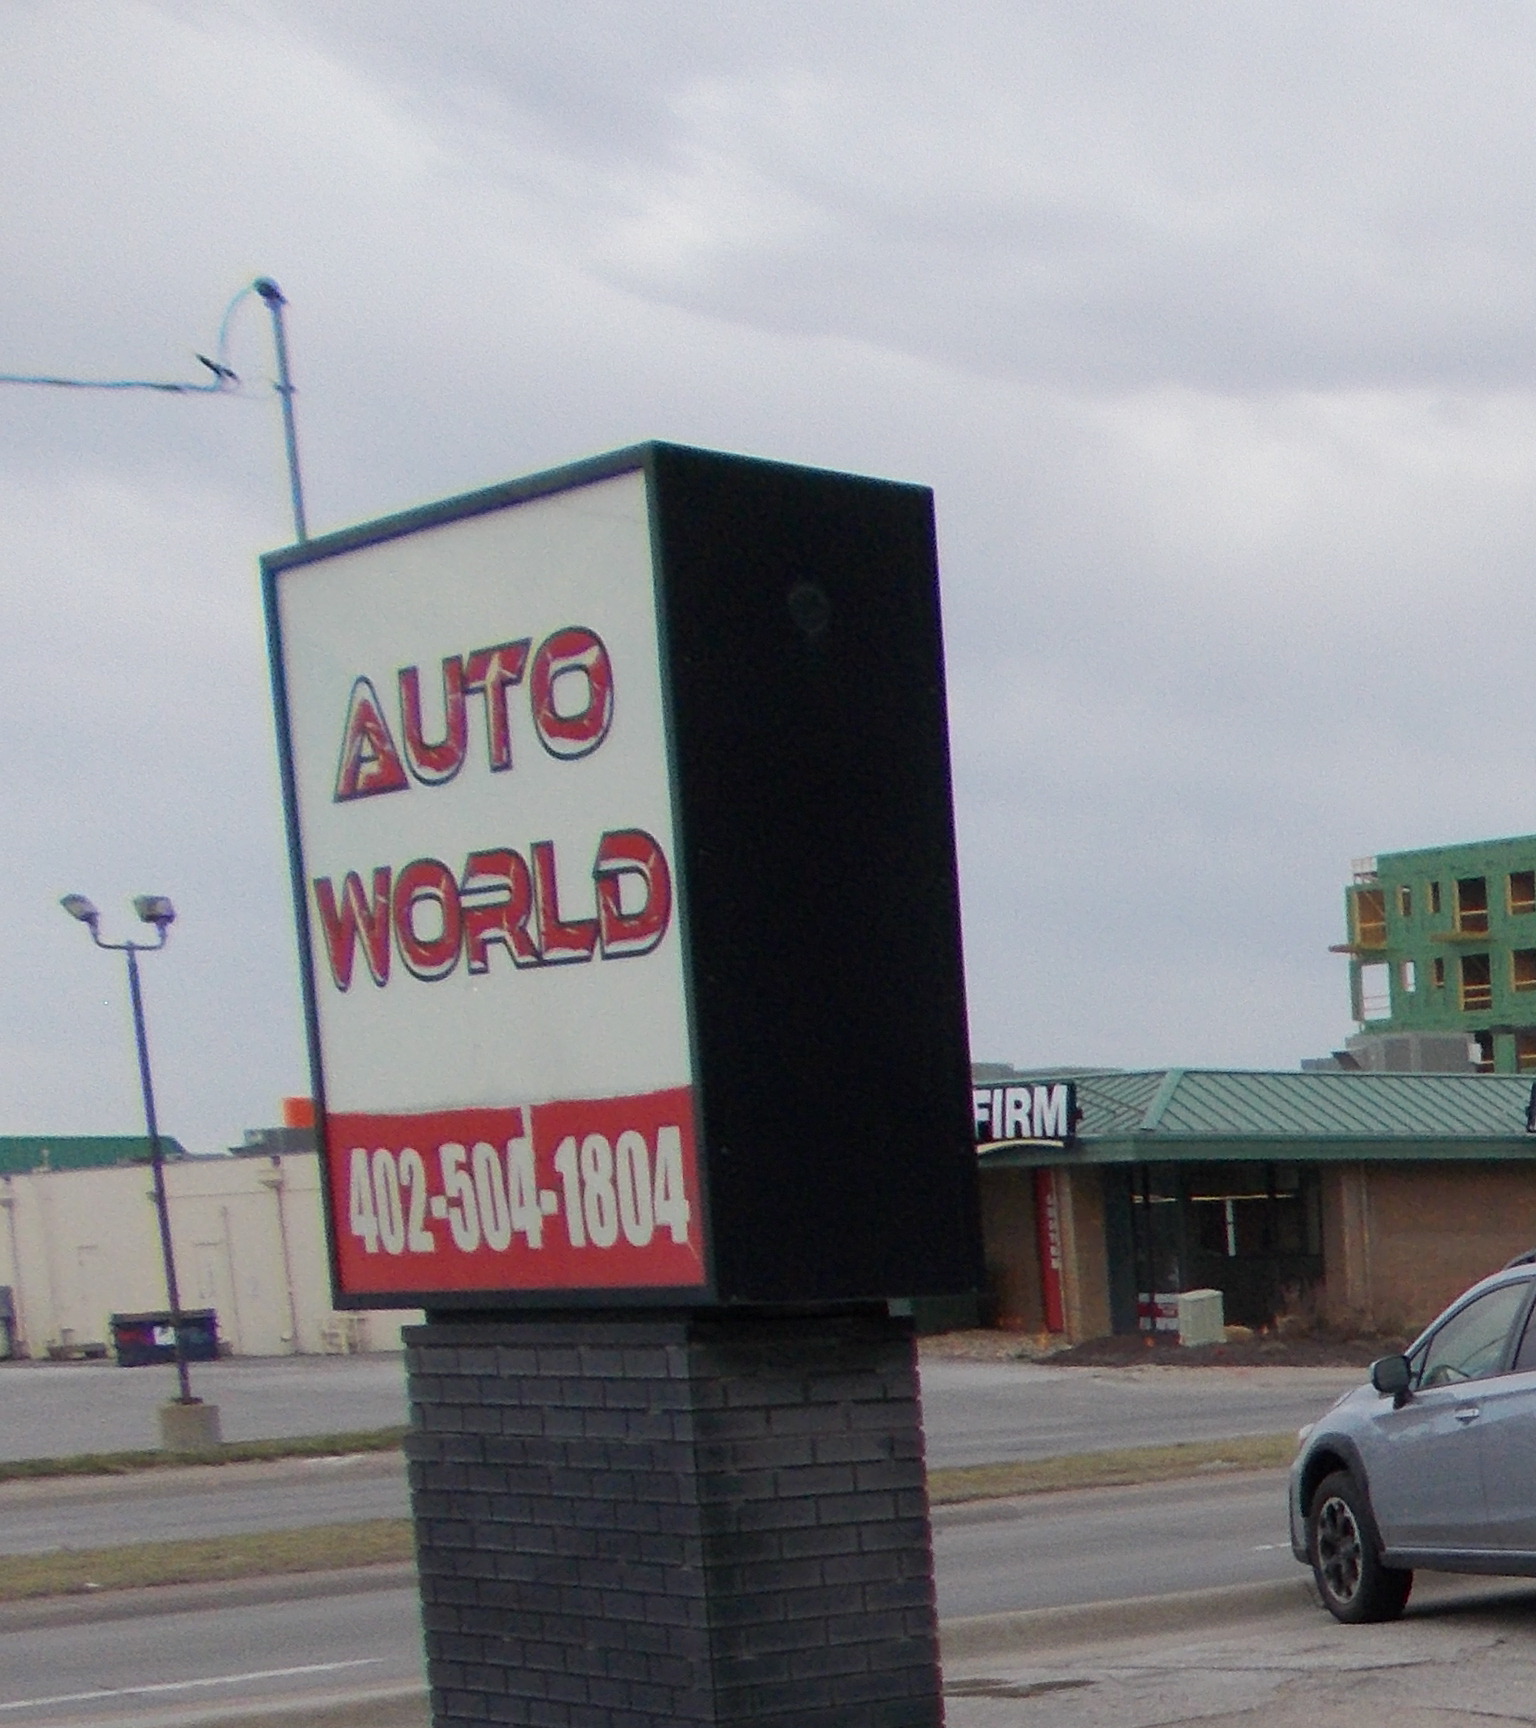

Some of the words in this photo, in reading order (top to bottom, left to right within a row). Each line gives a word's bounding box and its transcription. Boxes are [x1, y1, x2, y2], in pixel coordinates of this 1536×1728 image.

[334, 626, 614, 802] AUTO
[313, 828, 673, 992] WORLD
[349, 1125, 690, 1255] 402-504-1804
